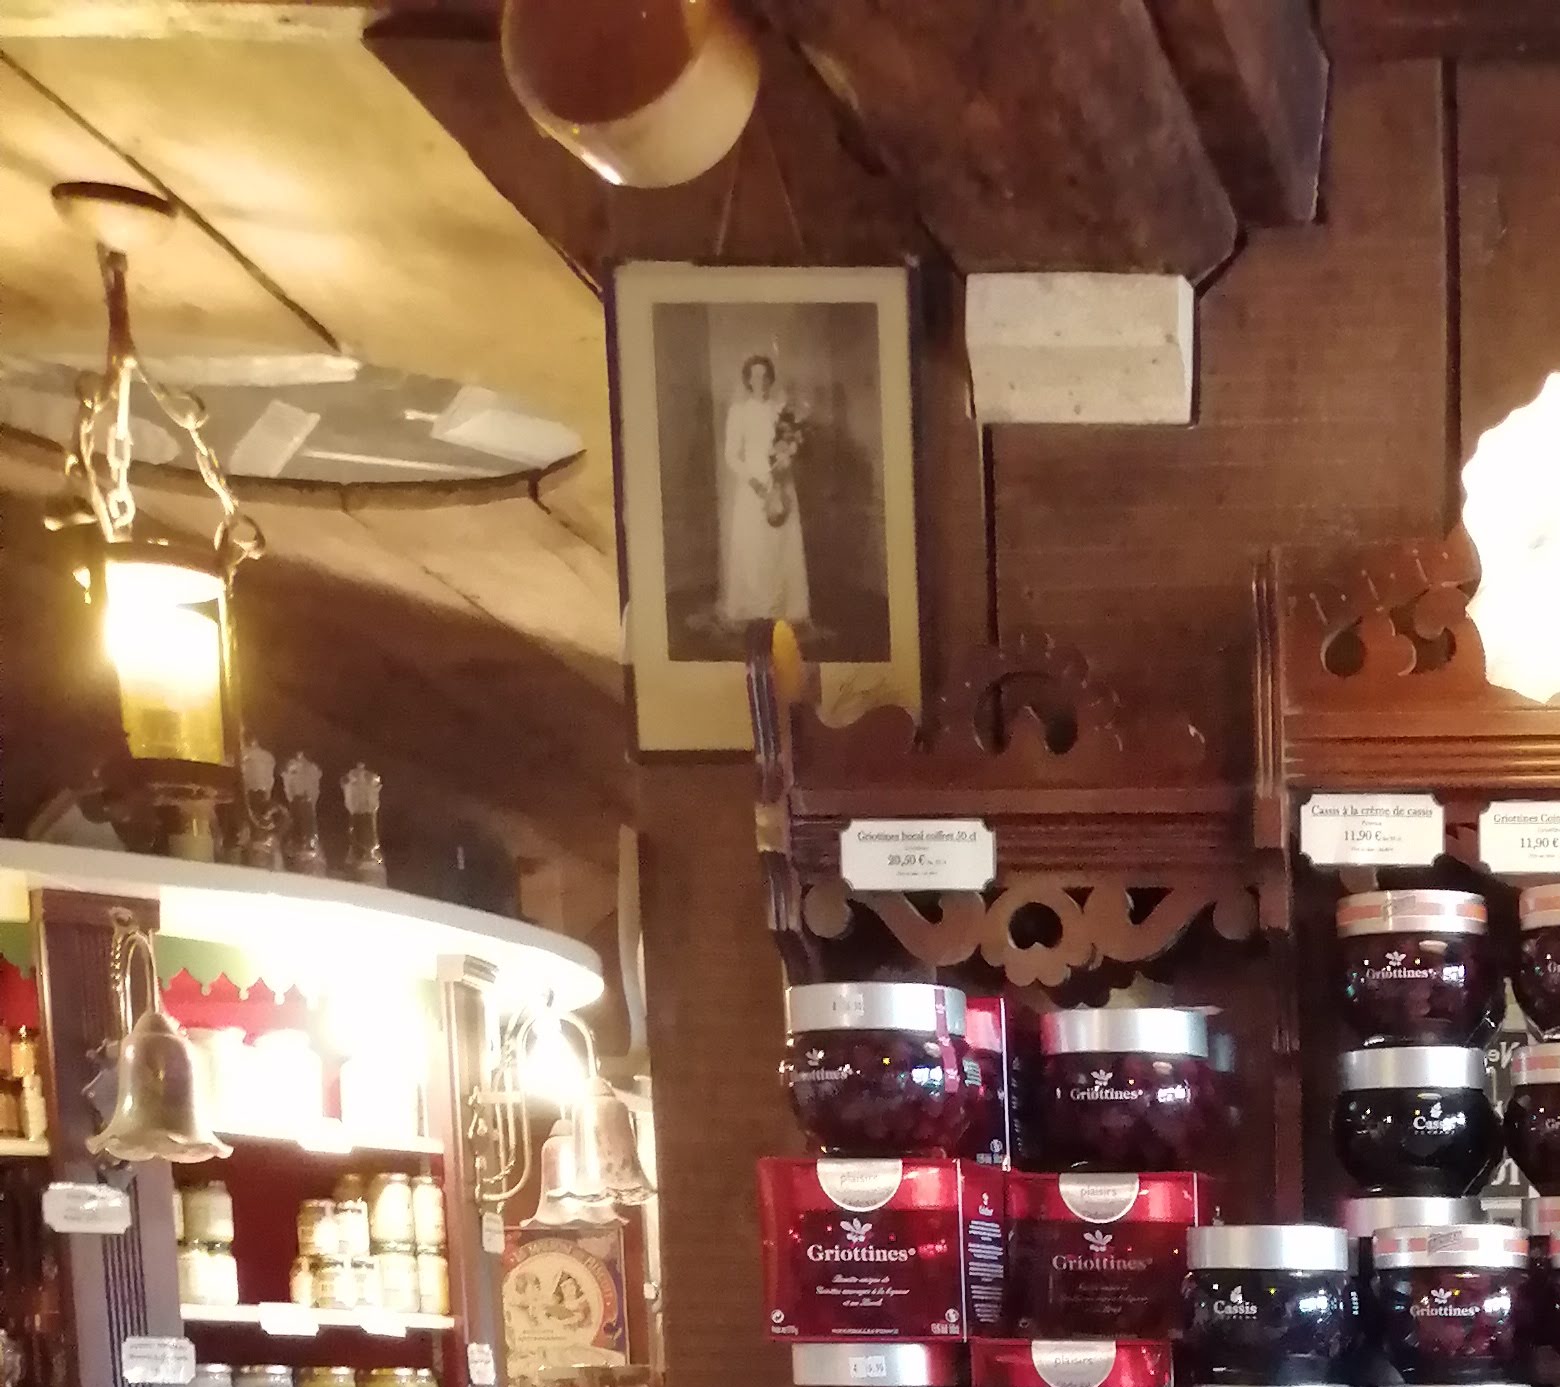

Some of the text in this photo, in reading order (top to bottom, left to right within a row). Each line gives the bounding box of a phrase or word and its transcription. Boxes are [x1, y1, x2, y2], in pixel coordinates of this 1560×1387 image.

[1311, 805, 1338, 816] Cassis
[1350, 805, 1358, 816] la
[1393, 804, 1404, 816] de
[1407, 805, 1432, 816] cassis
[1374, 830, 1381, 841] €
[1552, 837, 1559, 848] €
